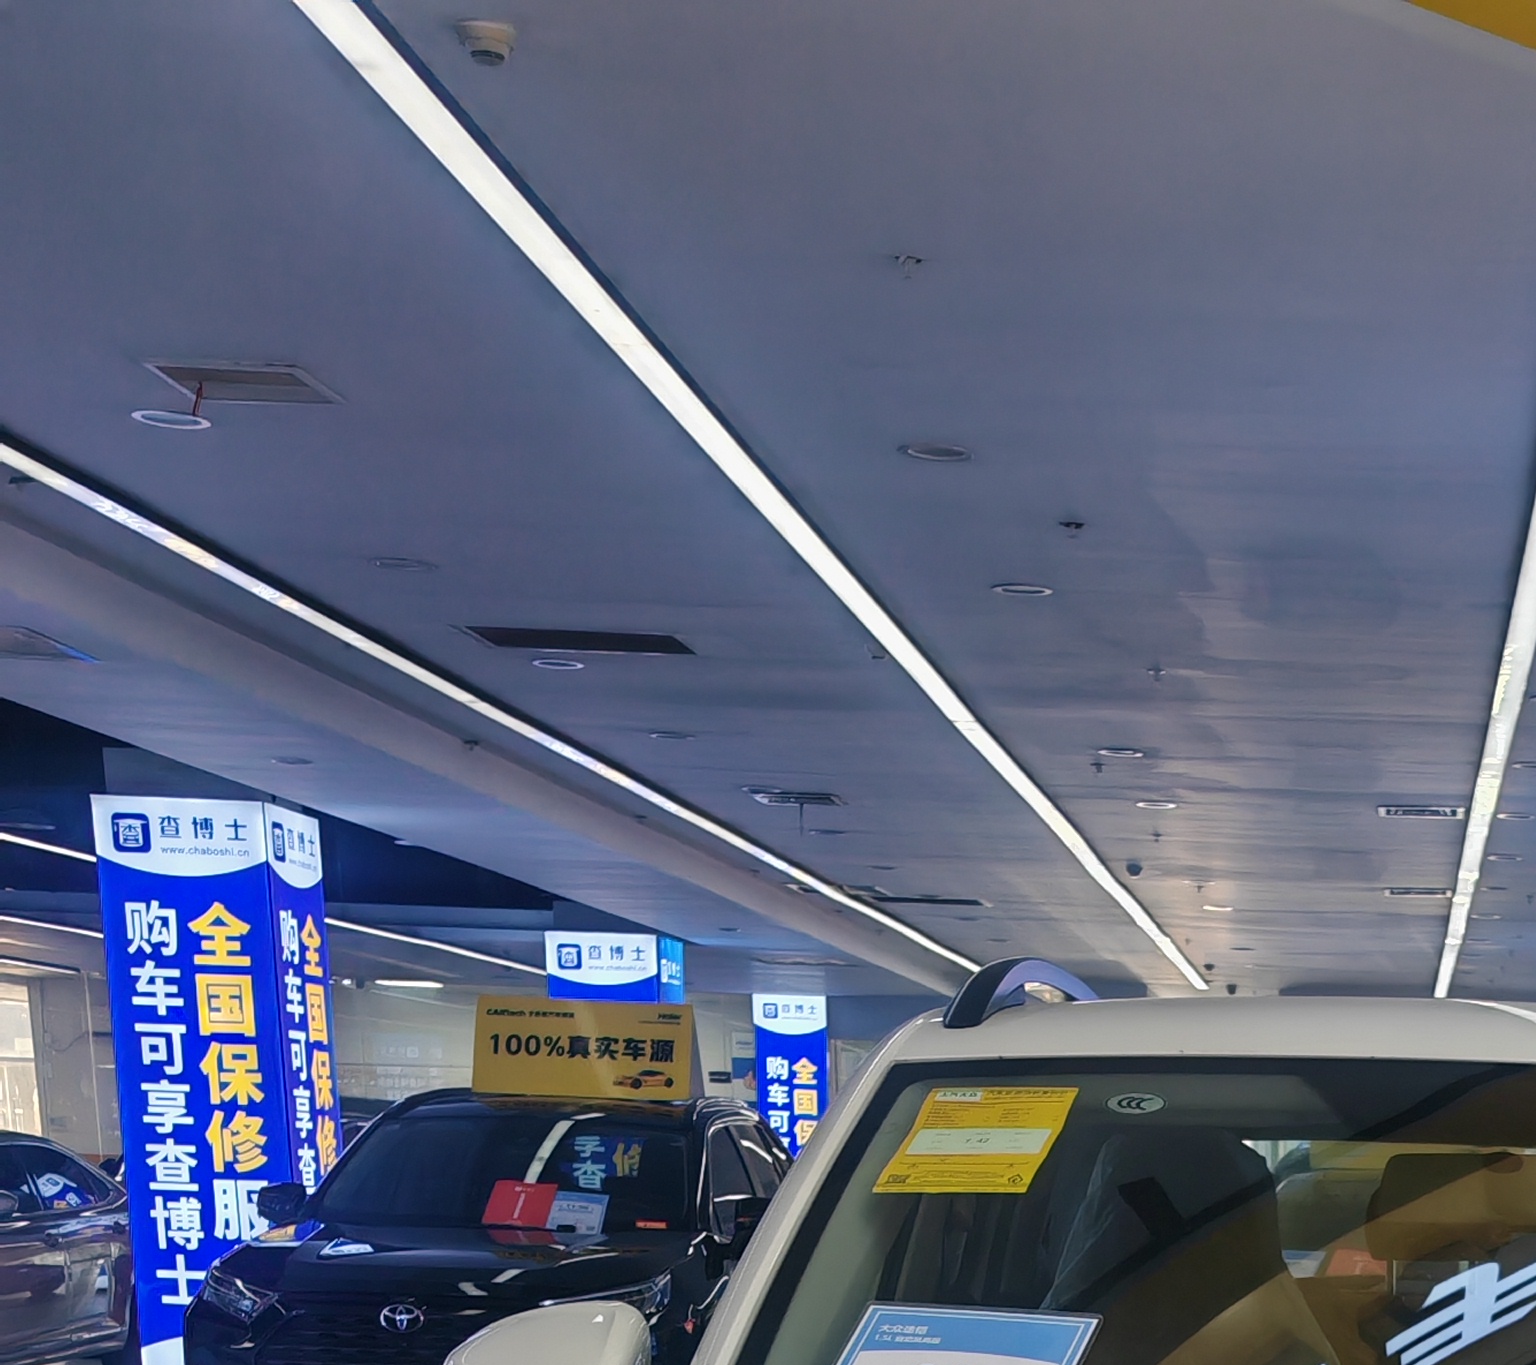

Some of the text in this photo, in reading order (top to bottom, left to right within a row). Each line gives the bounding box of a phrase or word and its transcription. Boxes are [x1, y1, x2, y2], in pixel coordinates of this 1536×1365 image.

[158, 815, 248, 842] 查博士
[160, 845, 250, 858] www.chaboshi.cn
[300, 913, 338, 1176] 全国保修
[489, 1033, 676, 1063] 100%真实车源
